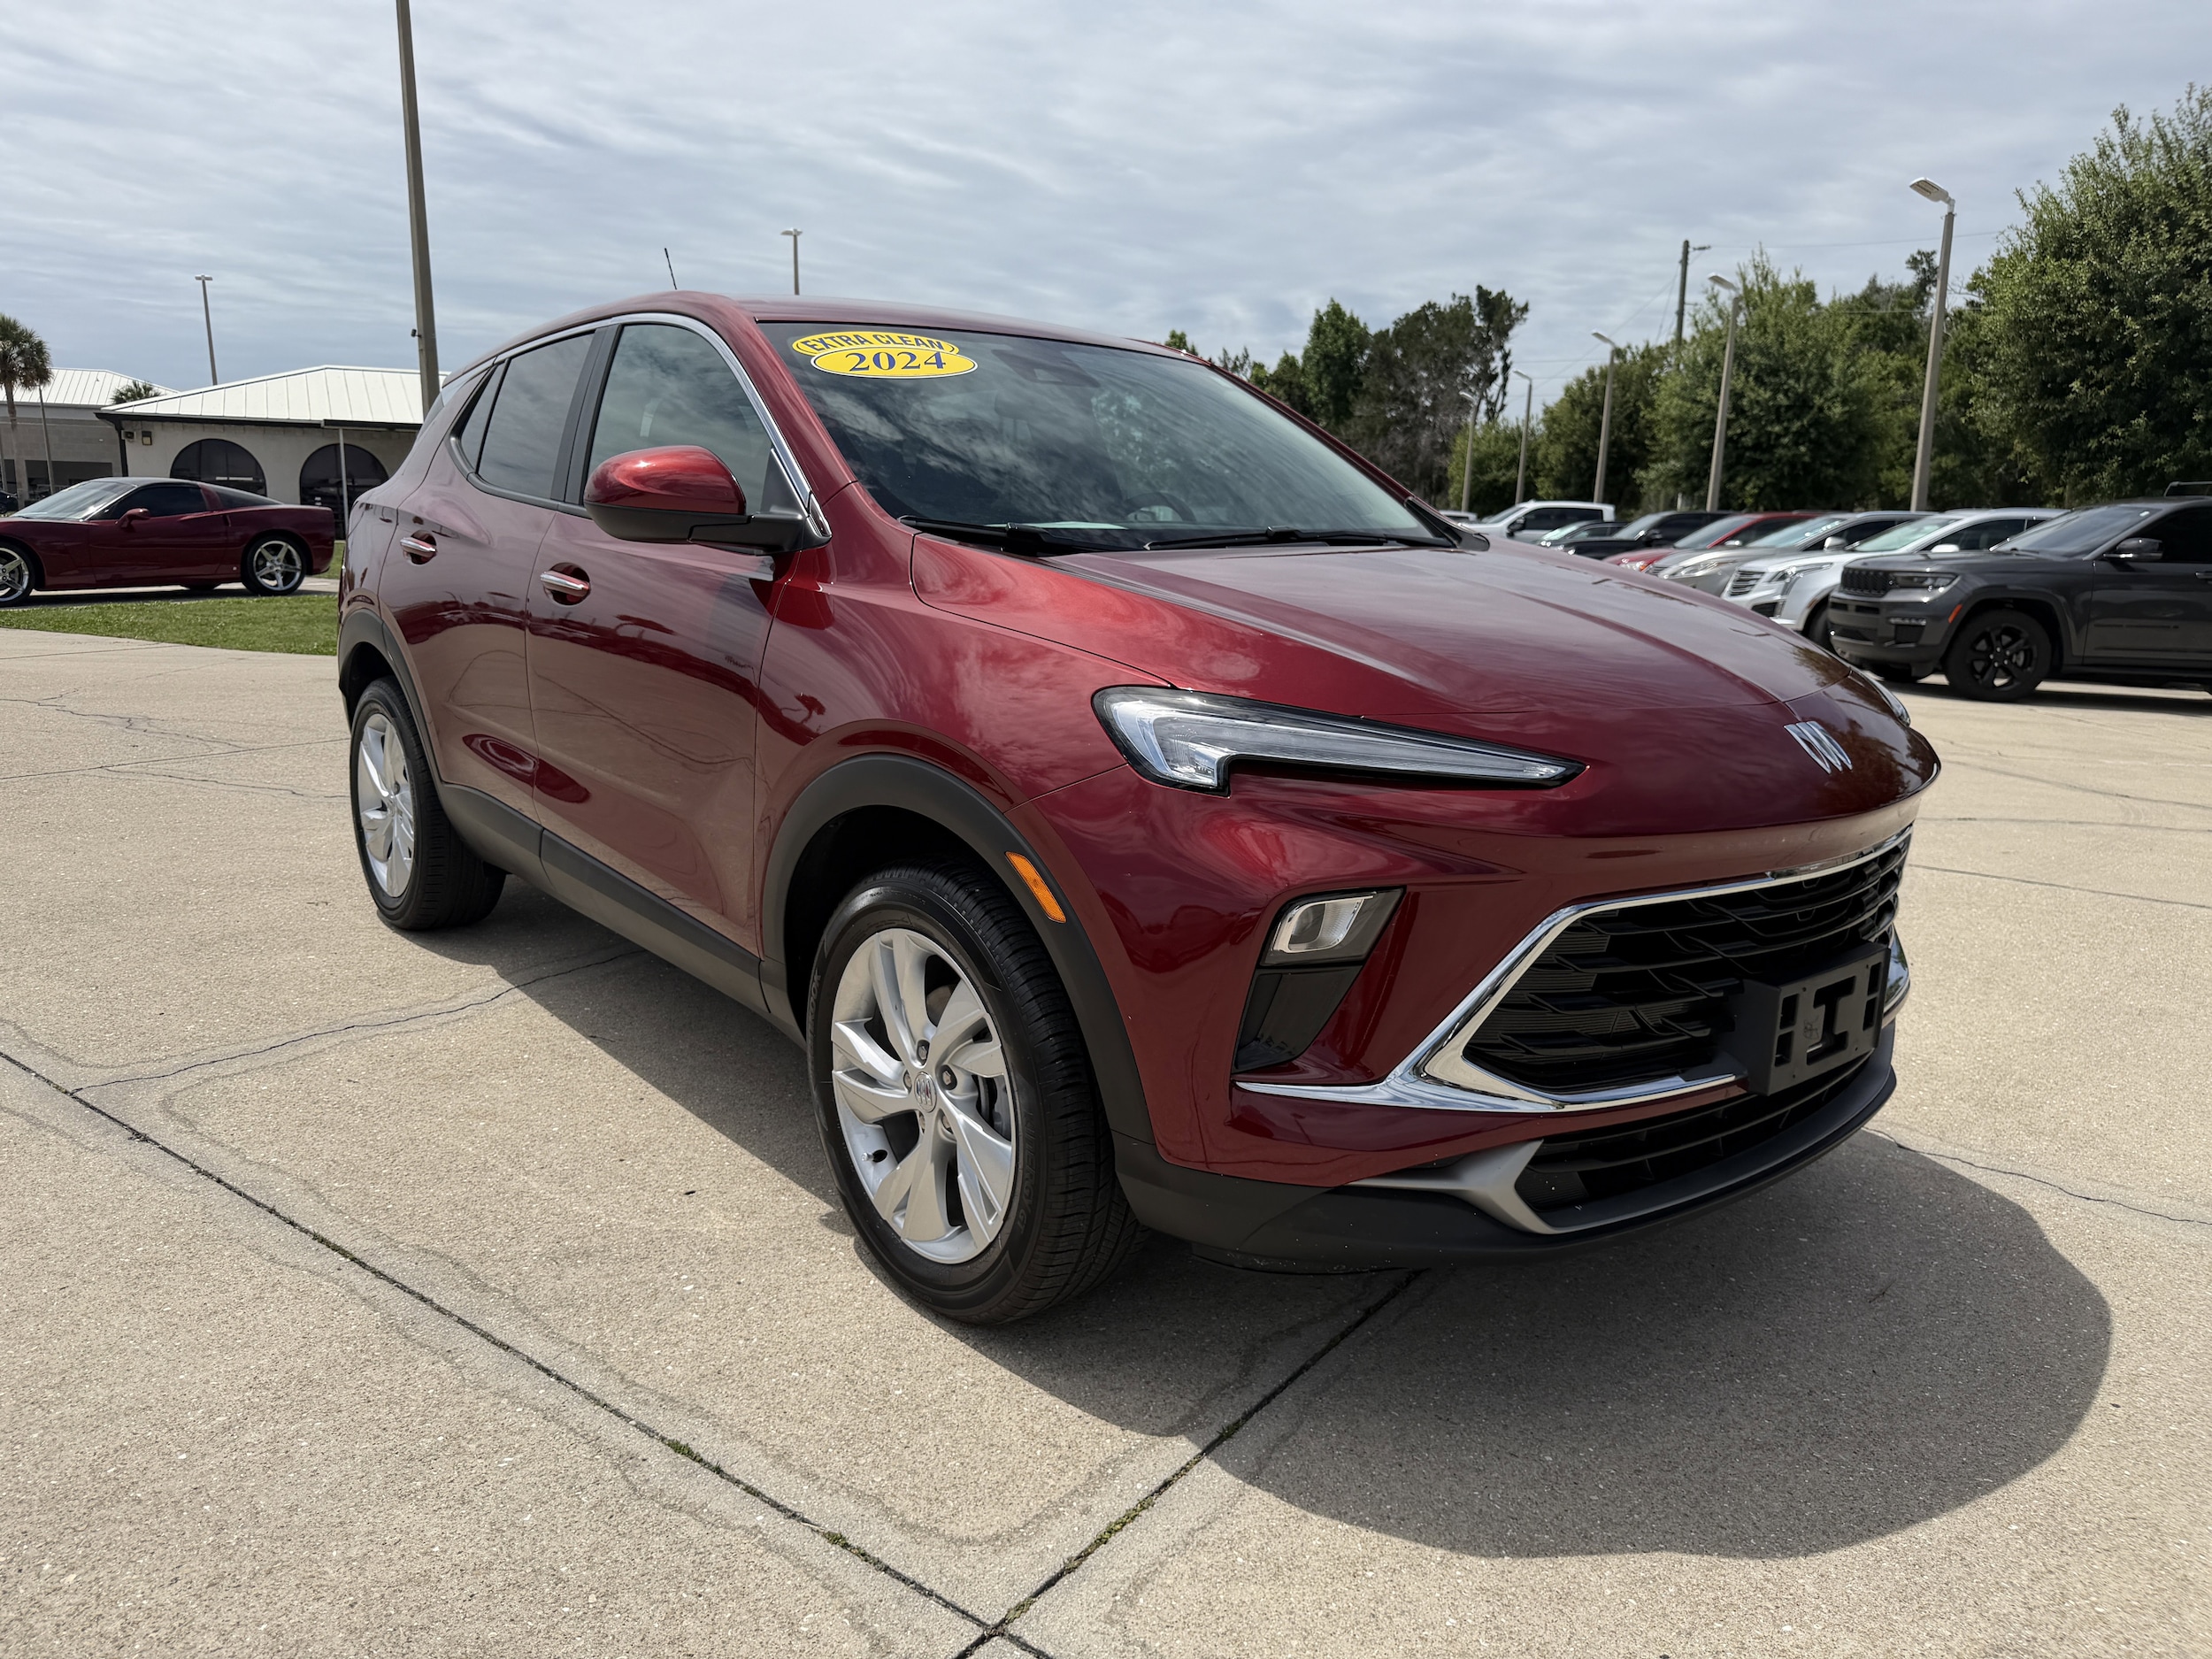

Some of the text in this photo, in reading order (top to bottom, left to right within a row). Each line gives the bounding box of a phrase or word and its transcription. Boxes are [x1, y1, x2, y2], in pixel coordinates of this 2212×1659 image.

[800, 334, 945, 352] EXTRA CLEAN
[844, 350, 947, 372] 2024
